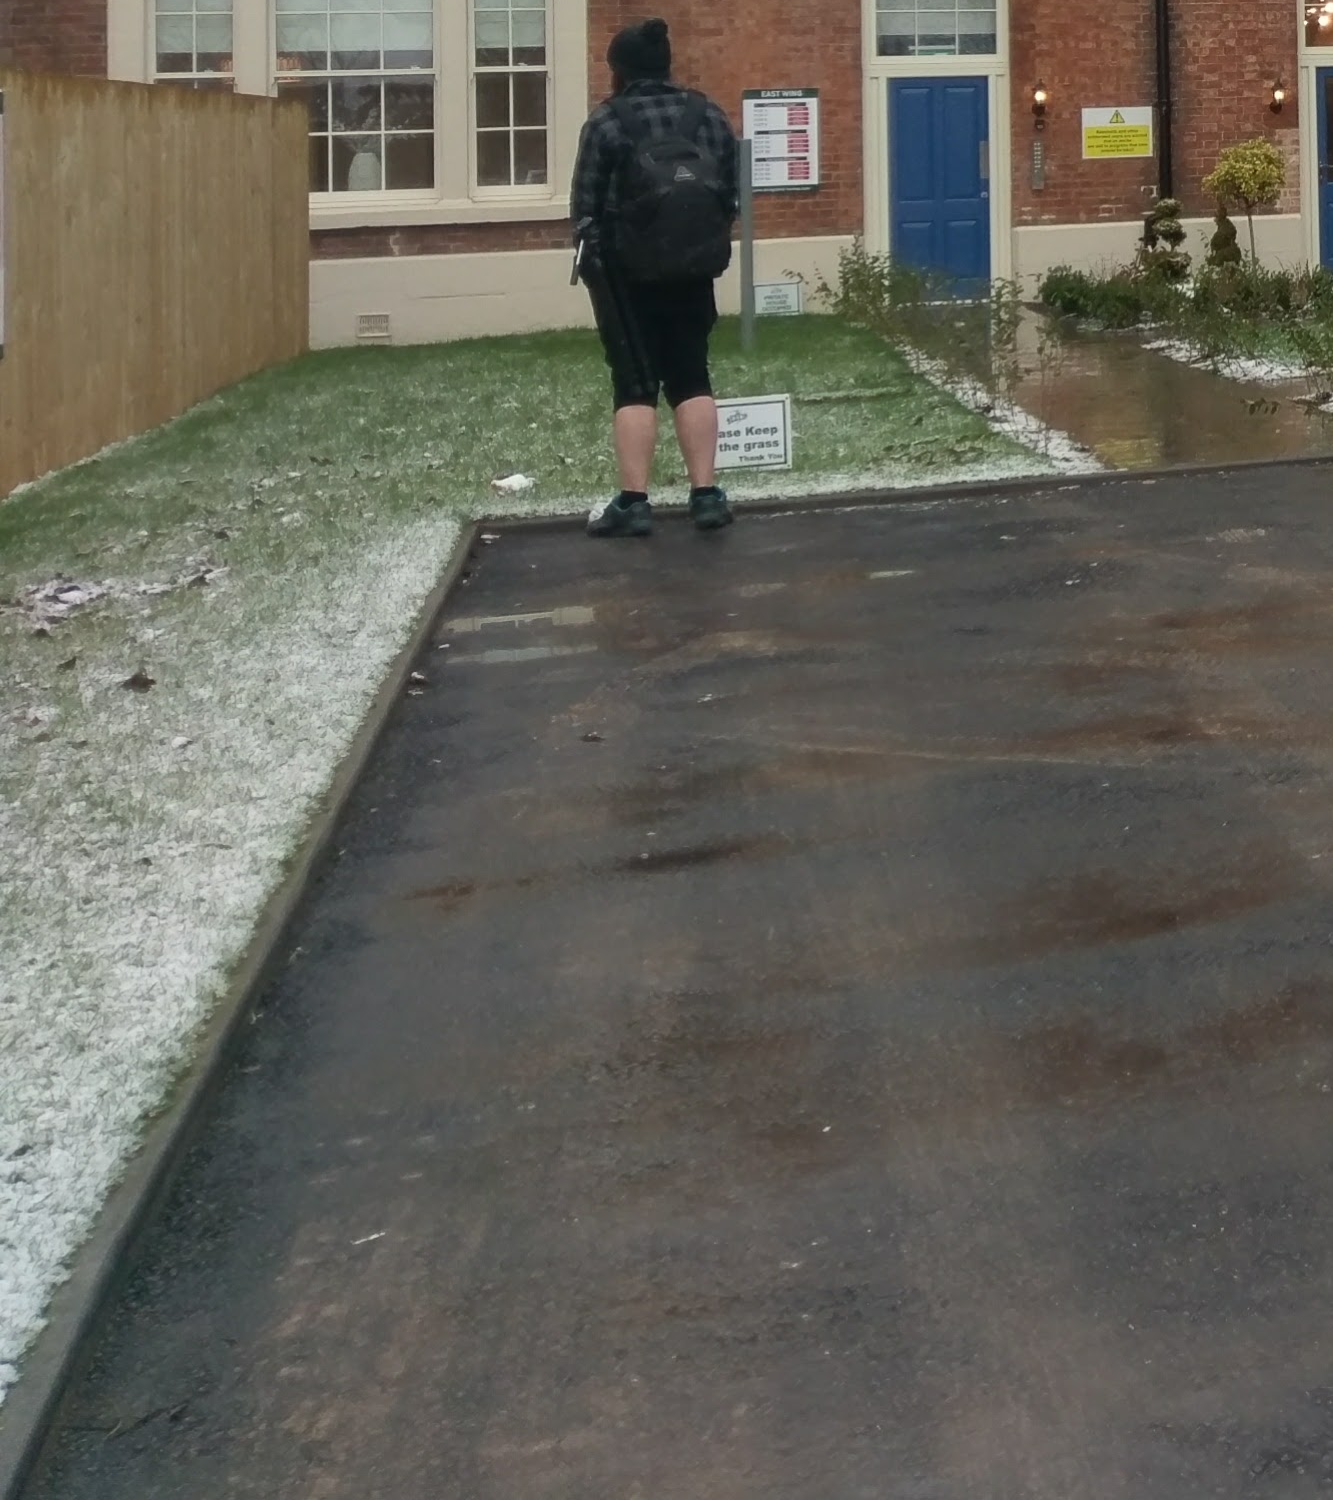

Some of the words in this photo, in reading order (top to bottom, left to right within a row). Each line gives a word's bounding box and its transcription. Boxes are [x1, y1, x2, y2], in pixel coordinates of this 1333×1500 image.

[718, 429, 741, 438] ase
[745, 426, 778, 437] Keep
[719, 442, 739, 452] the
[744, 439, 779, 452] grass
[739, 454, 764, 462] Thank
